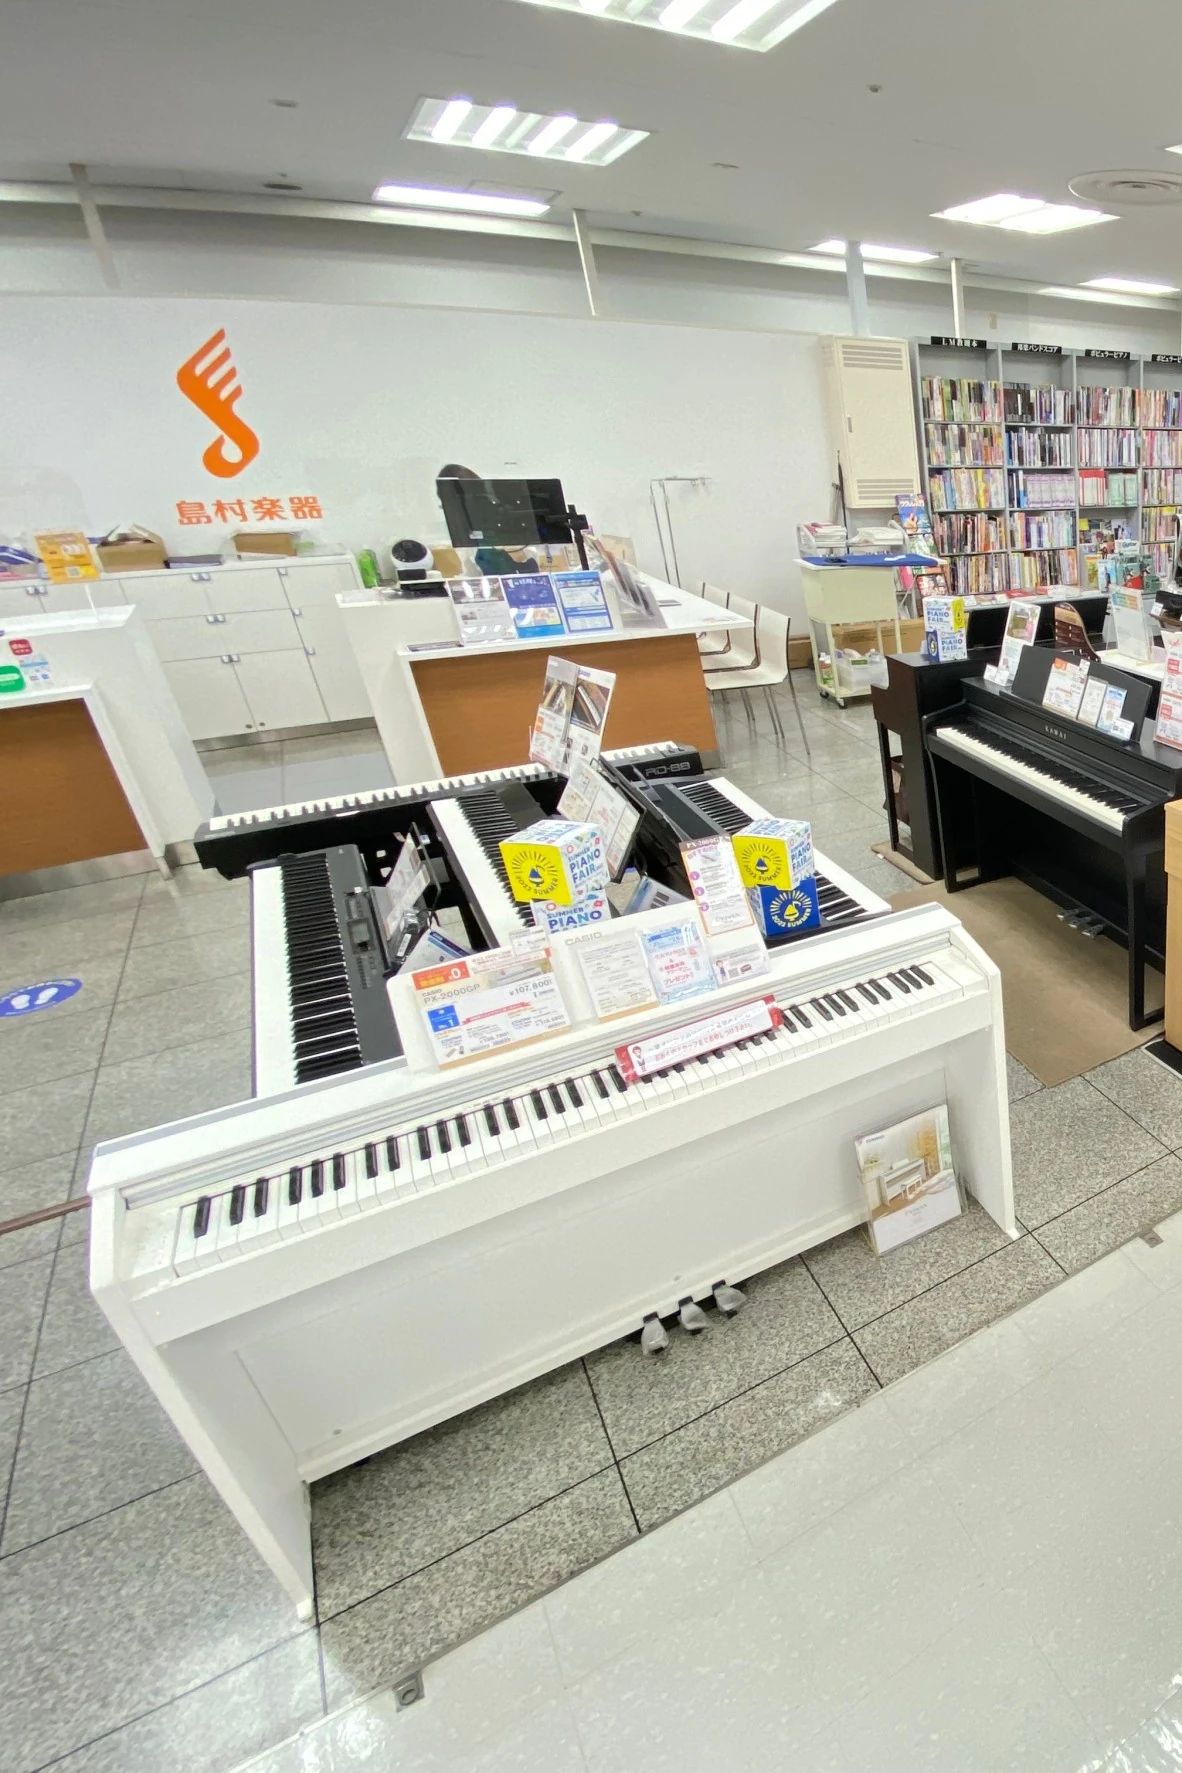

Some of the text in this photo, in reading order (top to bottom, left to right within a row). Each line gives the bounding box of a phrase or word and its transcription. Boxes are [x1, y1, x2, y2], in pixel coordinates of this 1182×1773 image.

[176, 496, 323, 525] 島村楽器
[942, 638, 962, 646] PIANO
[1045, 725, 1067, 740] KAWAI
[646, 761, 690, 776] RD-88
[570, 848, 600, 874] PIANO
[572, 863, 596, 884] FAIR
[758, 867, 781, 882] SUMMER
[534, 877, 558, 895] SUMMER
[546, 907, 584, 918] SUMMER
[548, 910, 602, 930] PIANO
[787, 908, 811, 928] SUMMER
[566, 932, 602, 946] CASIO
[424, 983, 481, 1005] PX-2000GP
